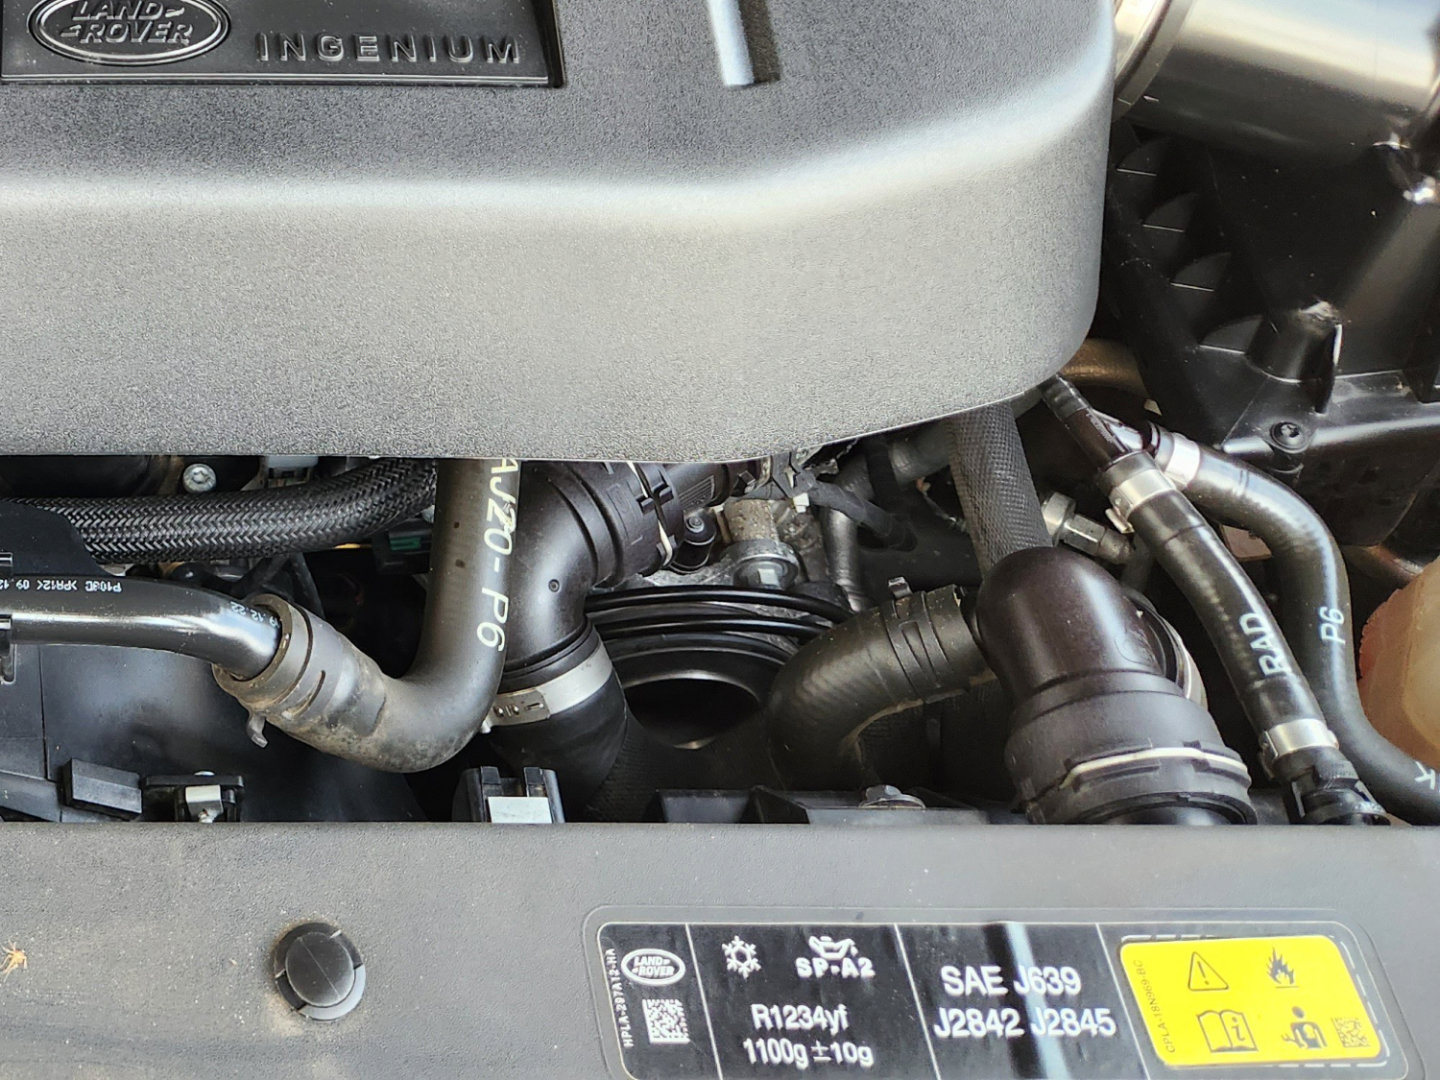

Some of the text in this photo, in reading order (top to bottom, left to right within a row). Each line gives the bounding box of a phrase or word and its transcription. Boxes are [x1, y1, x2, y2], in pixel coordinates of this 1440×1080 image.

[71, 0, 167, 22] LAND
[80, 21, 194, 45] ROVER
[257, 32, 522, 65] INGENIUM
[1238, 612, 1293, 677] RAD
[634, 956, 664, 967] LAND
[638, 965, 675, 978] ROVER
[940, 965, 1082, 996] SAE J639
[750, 1003, 849, 1036] R1234yf
[933, 1007, 1117, 1038] J2842 J2845
